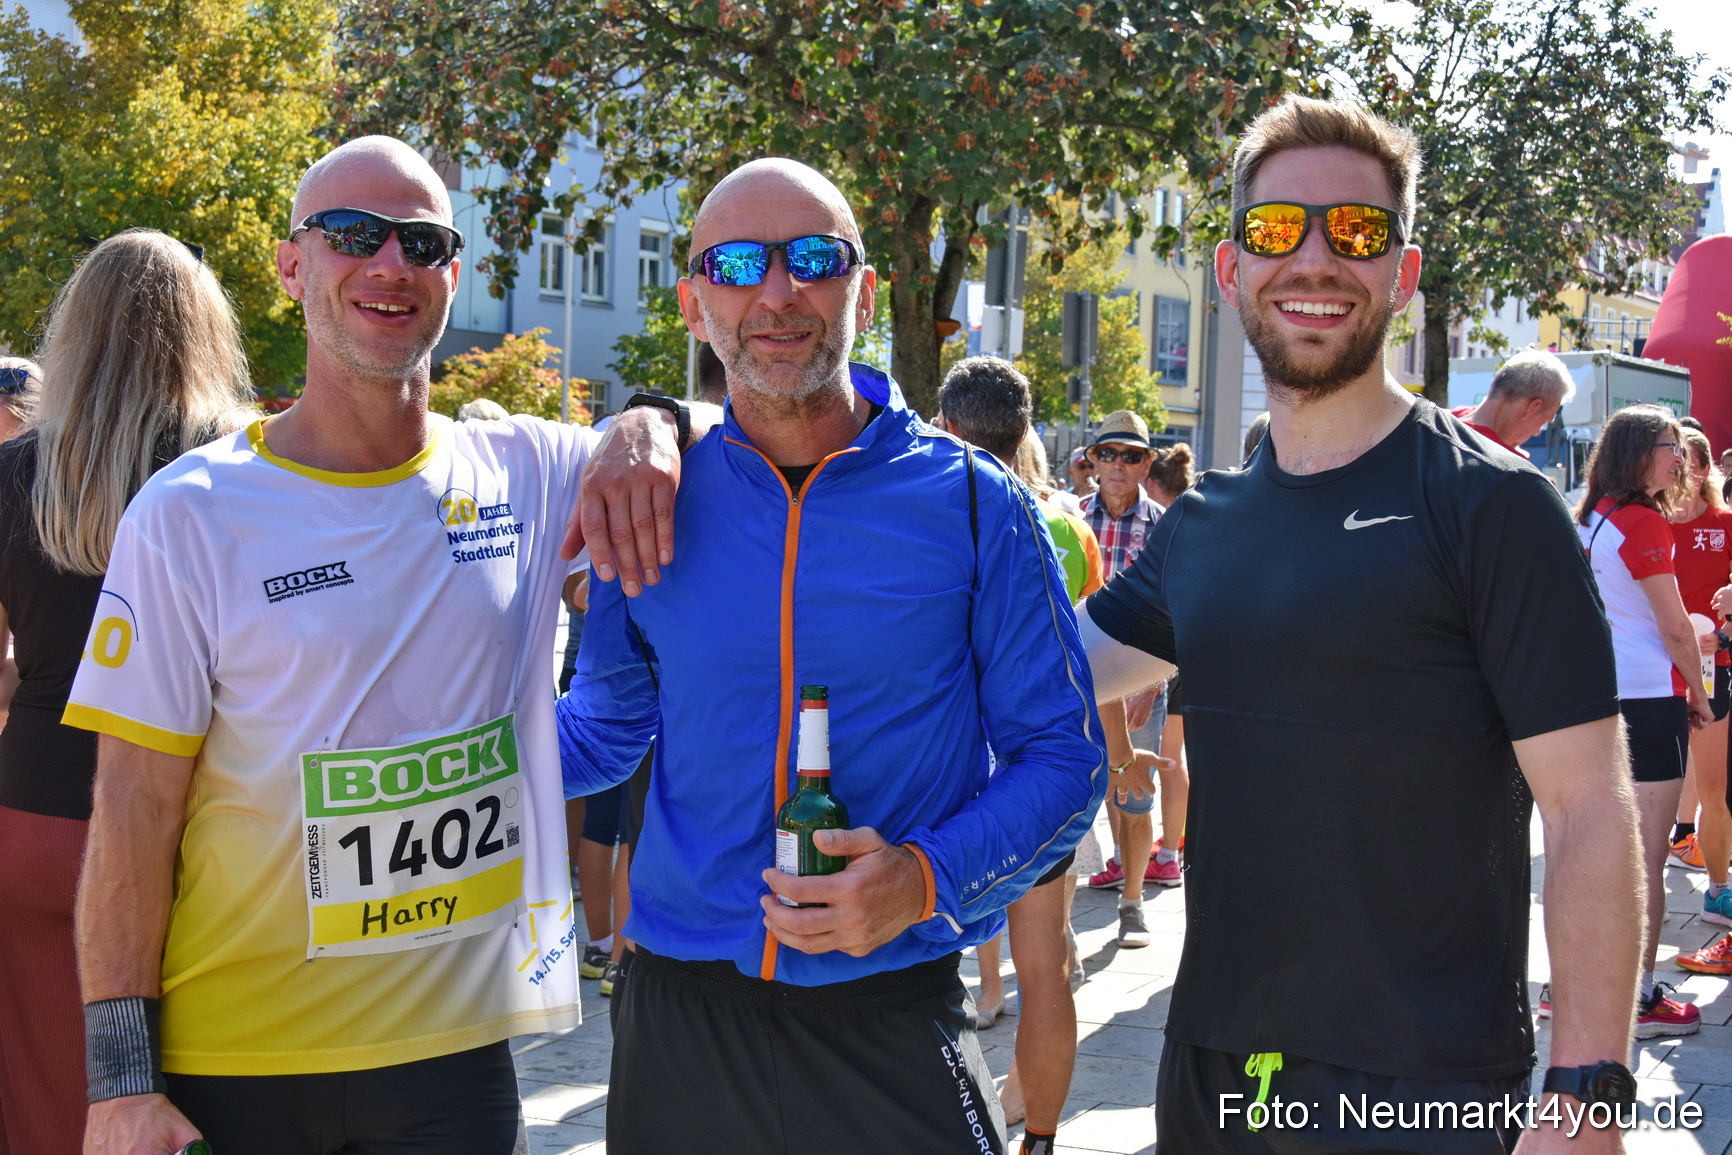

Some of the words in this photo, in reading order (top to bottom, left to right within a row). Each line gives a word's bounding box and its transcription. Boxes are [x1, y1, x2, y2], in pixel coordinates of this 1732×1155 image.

[441, 498, 477, 527] 20
[482, 505, 509, 519] JAHRE
[447, 522, 524, 545] Neumarkter
[452, 541, 515, 563] Stadtlauf
[264, 561, 352, 597] BOCK
[269, 592, 295, 603] inspired
[305, 584, 325, 593] smart
[325, 578, 354, 589] concepts
[81, 616, 132, 669] 0
[325, 730, 504, 805] BOCK
[338, 795, 504, 886] 1402
[361, 896, 458, 936] Harry
[529, 948, 564, 986] 14./15.
